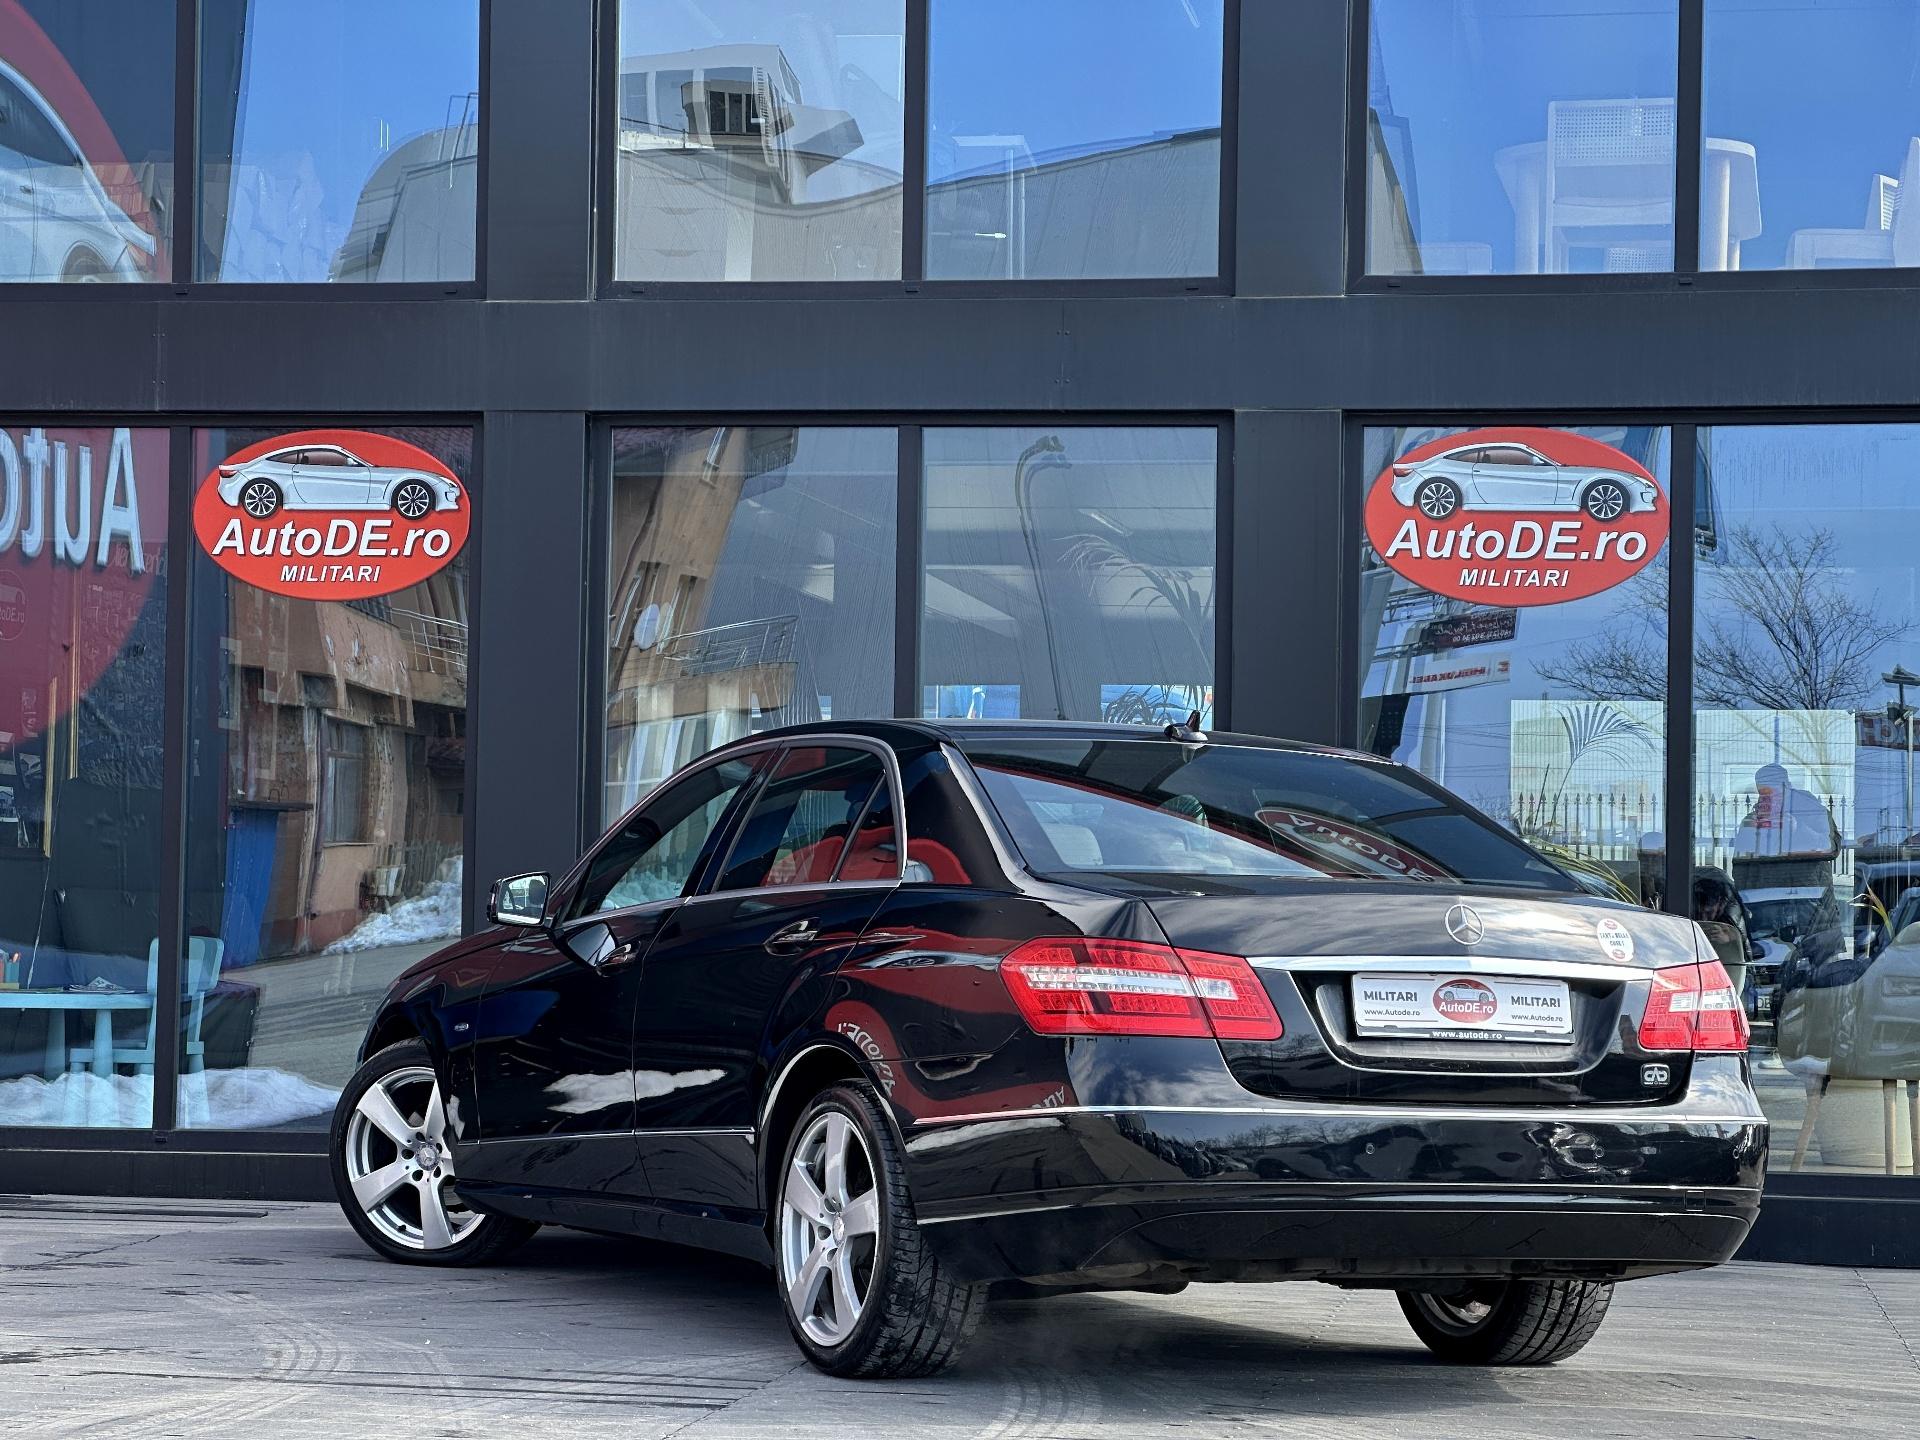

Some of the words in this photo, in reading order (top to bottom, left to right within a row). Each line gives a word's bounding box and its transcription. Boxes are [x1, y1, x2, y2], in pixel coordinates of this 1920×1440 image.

[211, 518, 451, 558] AutoDE.ro
[1386, 519, 1647, 561] AutoDE.ro
[280, 565, 382, 583] MILITARI
[1459, 568, 1569, 588] MILITARI
[1363, 990, 1418, 1002] MILITARI
[1511, 996, 1561, 1008] MILITARI
[1364, 1008, 1421, 1017] www.Autode.ro
[1438, 1001, 1494, 1015] AutoDE.ro
[1511, 1013, 1563, 1022] www.Autode.ro
[1432, 1030, 1503, 1040] www.autode.ro
